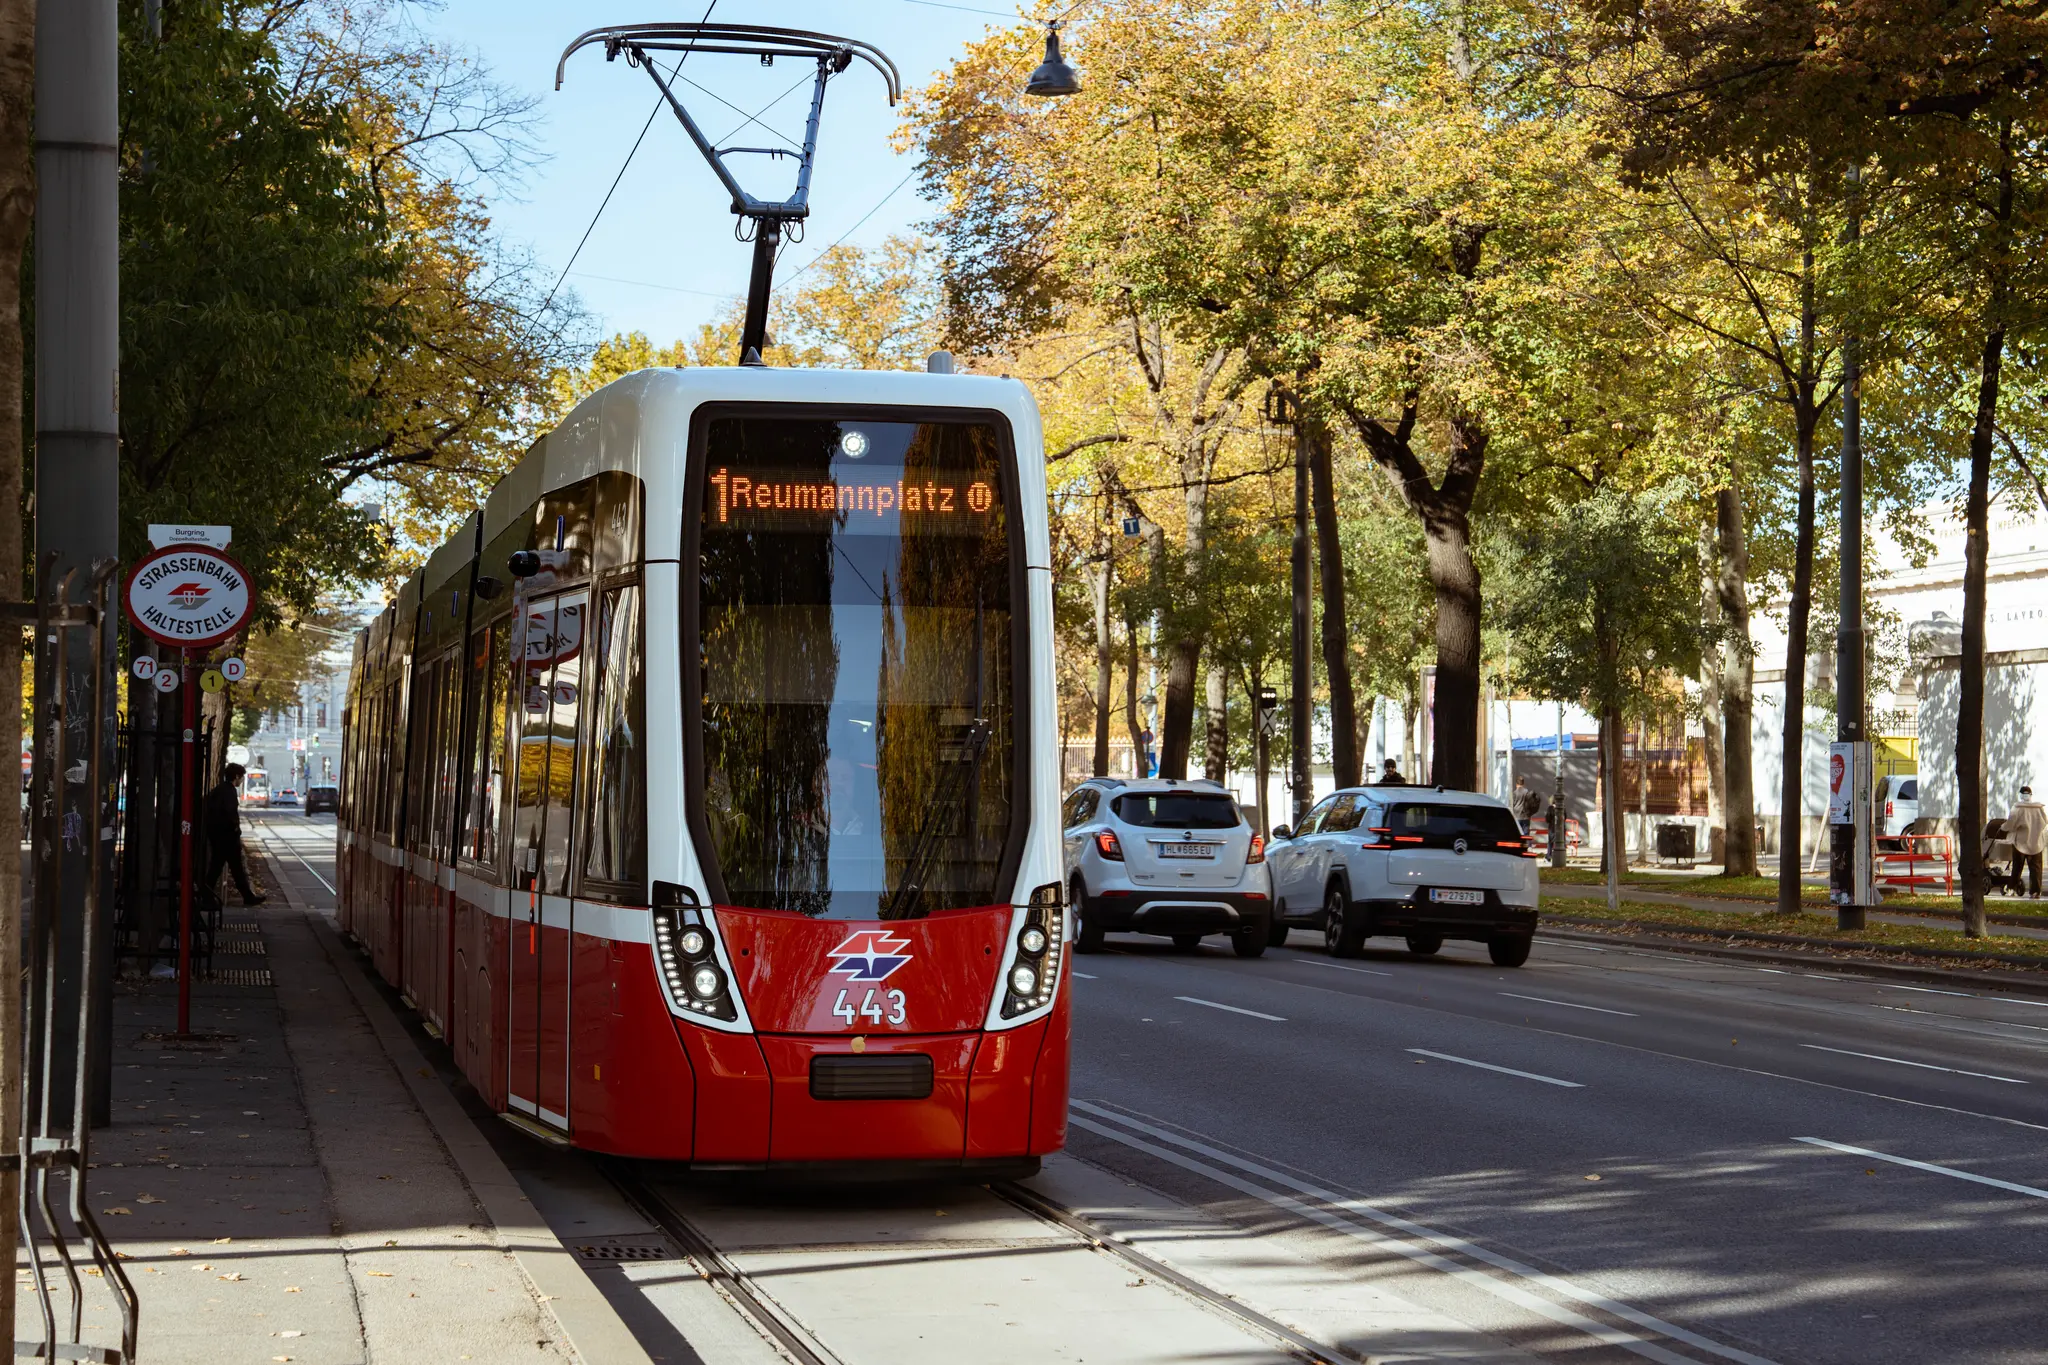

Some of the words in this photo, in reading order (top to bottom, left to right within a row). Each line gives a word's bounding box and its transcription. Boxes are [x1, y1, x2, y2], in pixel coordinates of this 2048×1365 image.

[711, 468, 727, 522] 1
[732, 477, 954, 516] Reumannplatz
[611, 502, 627, 534] 443
[175, 528, 205, 536] Burgring
[139, 557, 241, 592] STRASSENBAHN
[142, 605, 236, 635] HALTESTELLE
[137, 661, 154, 674] 71
[229, 663, 240, 675] D
[161, 674, 171, 687] 2
[208, 676, 216, 688] 1
[1166, 846, 1177, 854] HL
[1183, 846, 1199, 854] 665
[1201, 846, 1211, 855] EU
[1448, 892, 1474, 900] 27979
[832, 988, 906, 1025] 443
